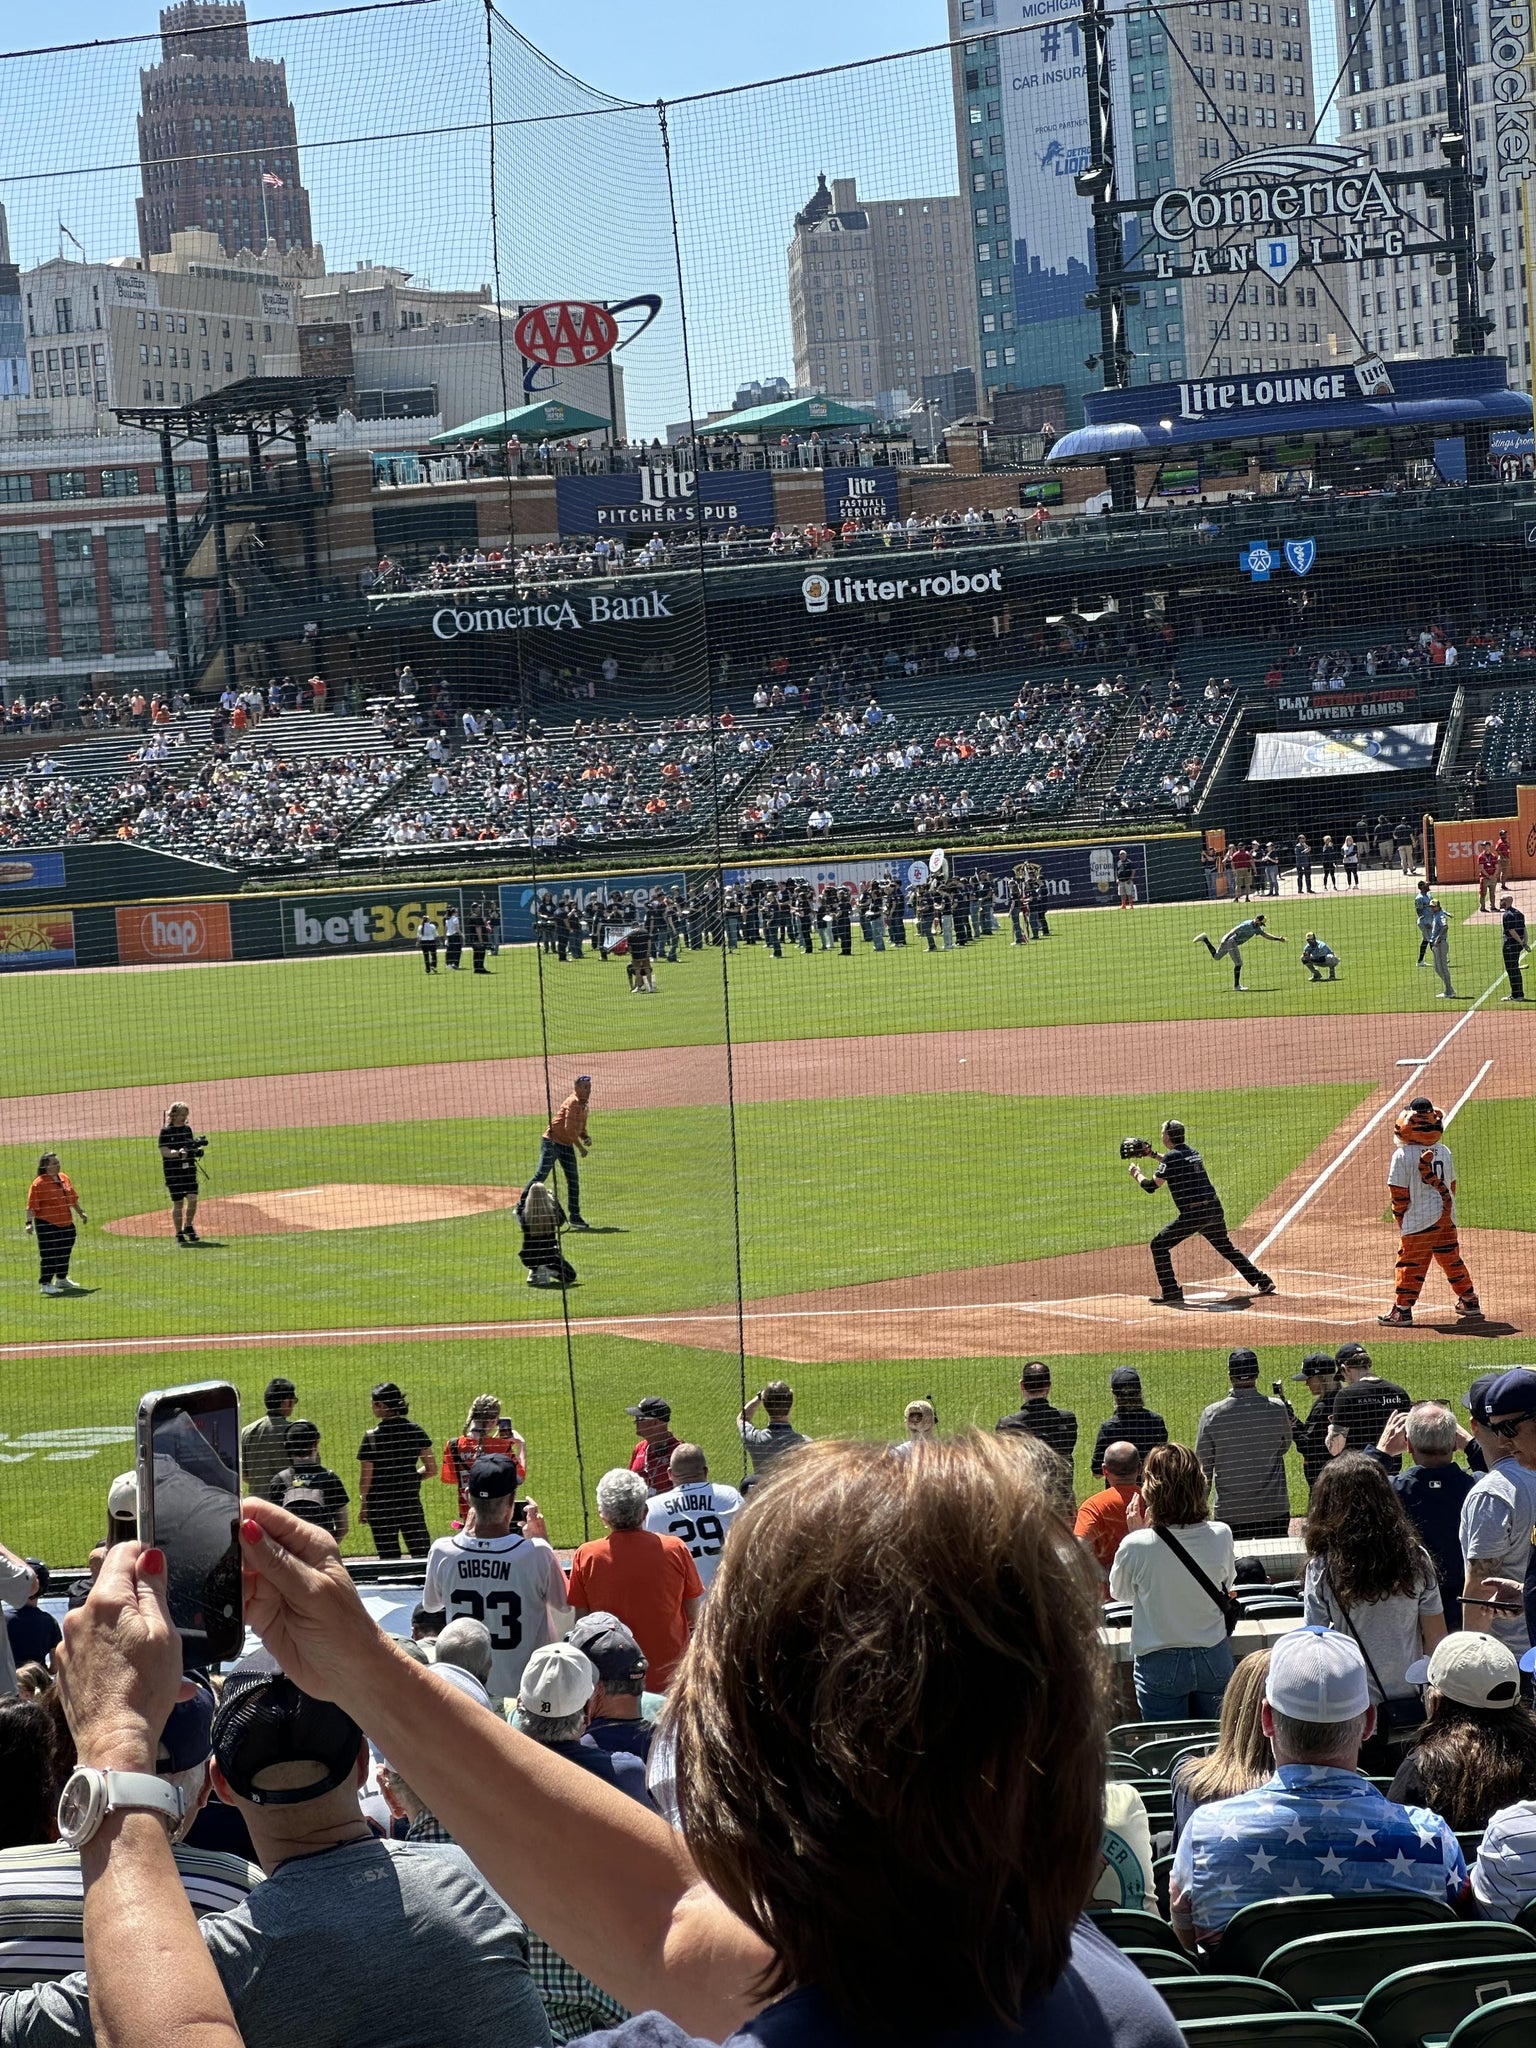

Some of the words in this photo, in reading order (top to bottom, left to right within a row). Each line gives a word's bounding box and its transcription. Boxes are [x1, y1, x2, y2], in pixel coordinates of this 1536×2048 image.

[1040, 20, 1080, 63] #1
[1012, 74, 1039, 91] CAR
[1042, 59, 1117, 85] INSURAE
[1035, 124, 1057, 134] PROUD
[1156, 229, 1405, 279] LANDING
[524, 303, 609, 364] AAA
[1360, 363, 1386, 386] Lite
[1178, 382, 1236, 420] Lite
[1241, 374, 1346, 406] LOUNGE
[638, 466, 695, 508] Lite
[847, 477, 876, 499] Lite
[598, 506, 695, 524] PITCHER'S
[704, 505, 738, 520] PUB
[839, 498, 887, 508] FASTBALL
[840, 506, 887, 518] SERVICE
[588, 590, 676, 623] Bank
[1279, 696, 1310, 710] PLAY
[1298, 705, 1356, 721] LOTTERY
[1361, 701, 1405, 716] GAMES
[151, 912, 197, 955] hap
[293, 902, 448, 946] bet365
[1381, 1395, 1402, 1407] jack
[664, 1494, 715, 1516] SKUBAL
[668, 1515, 724, 1559] 29
[457, 1559, 512, 1581] GIBSON
[450, 1588, 523, 1651] 23
